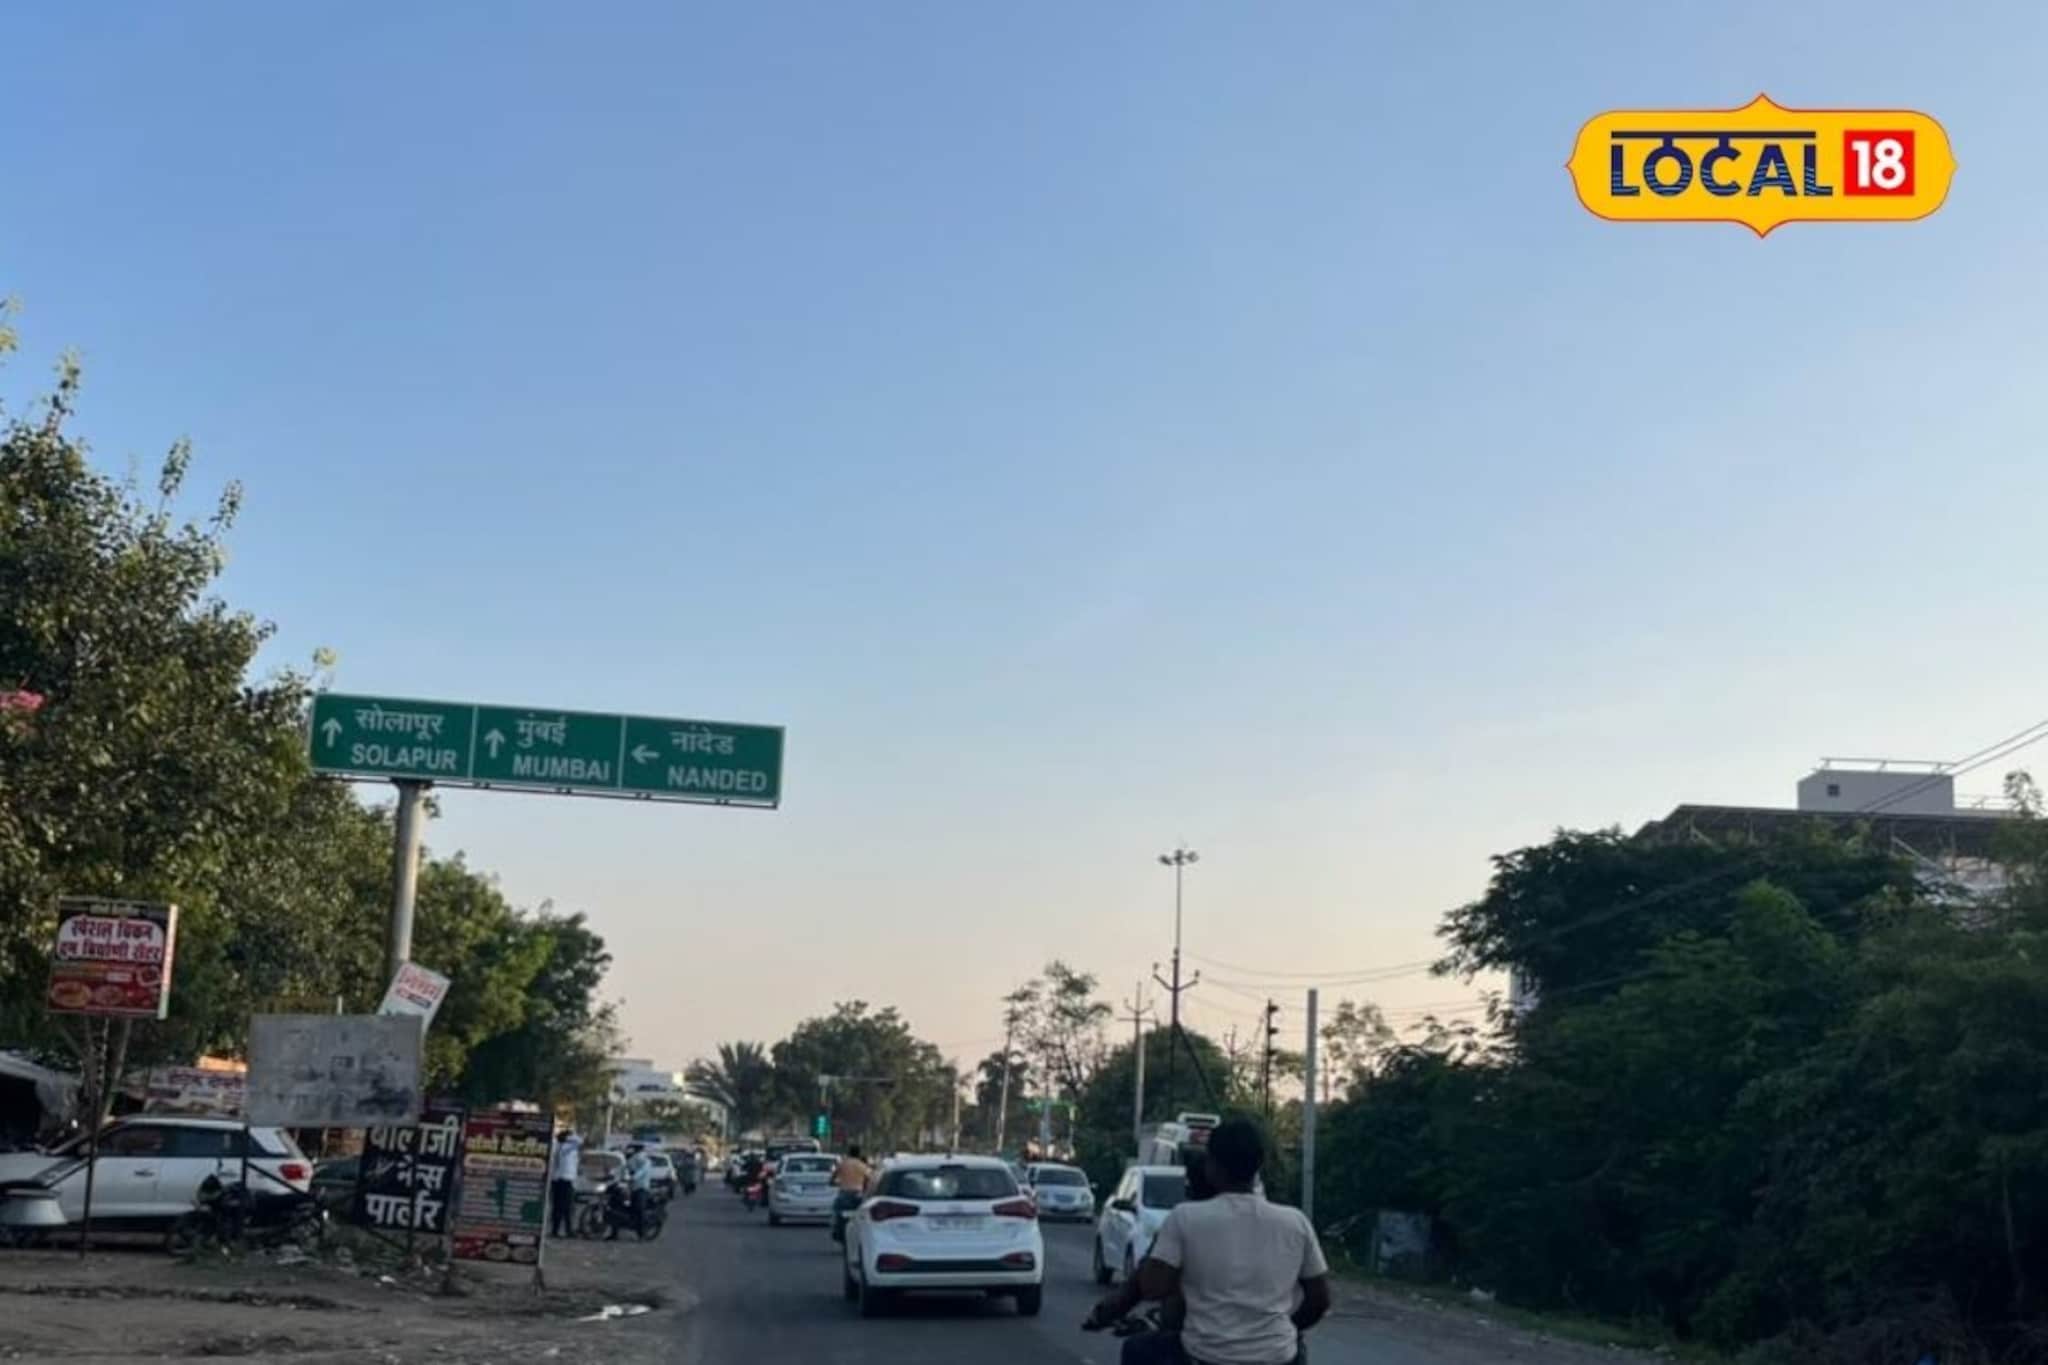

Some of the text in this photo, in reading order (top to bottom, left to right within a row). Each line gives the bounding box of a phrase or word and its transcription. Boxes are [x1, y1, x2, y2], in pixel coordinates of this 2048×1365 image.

[355, 703, 444, 741] सोलापूर
[515, 713, 567, 748] मुंबई
[670, 725, 737, 755] नांदेड
[351, 743, 458, 771] SOLAPUR
[512, 754, 611, 782] MUMBAI
[667, 765, 768, 792] NANDED
